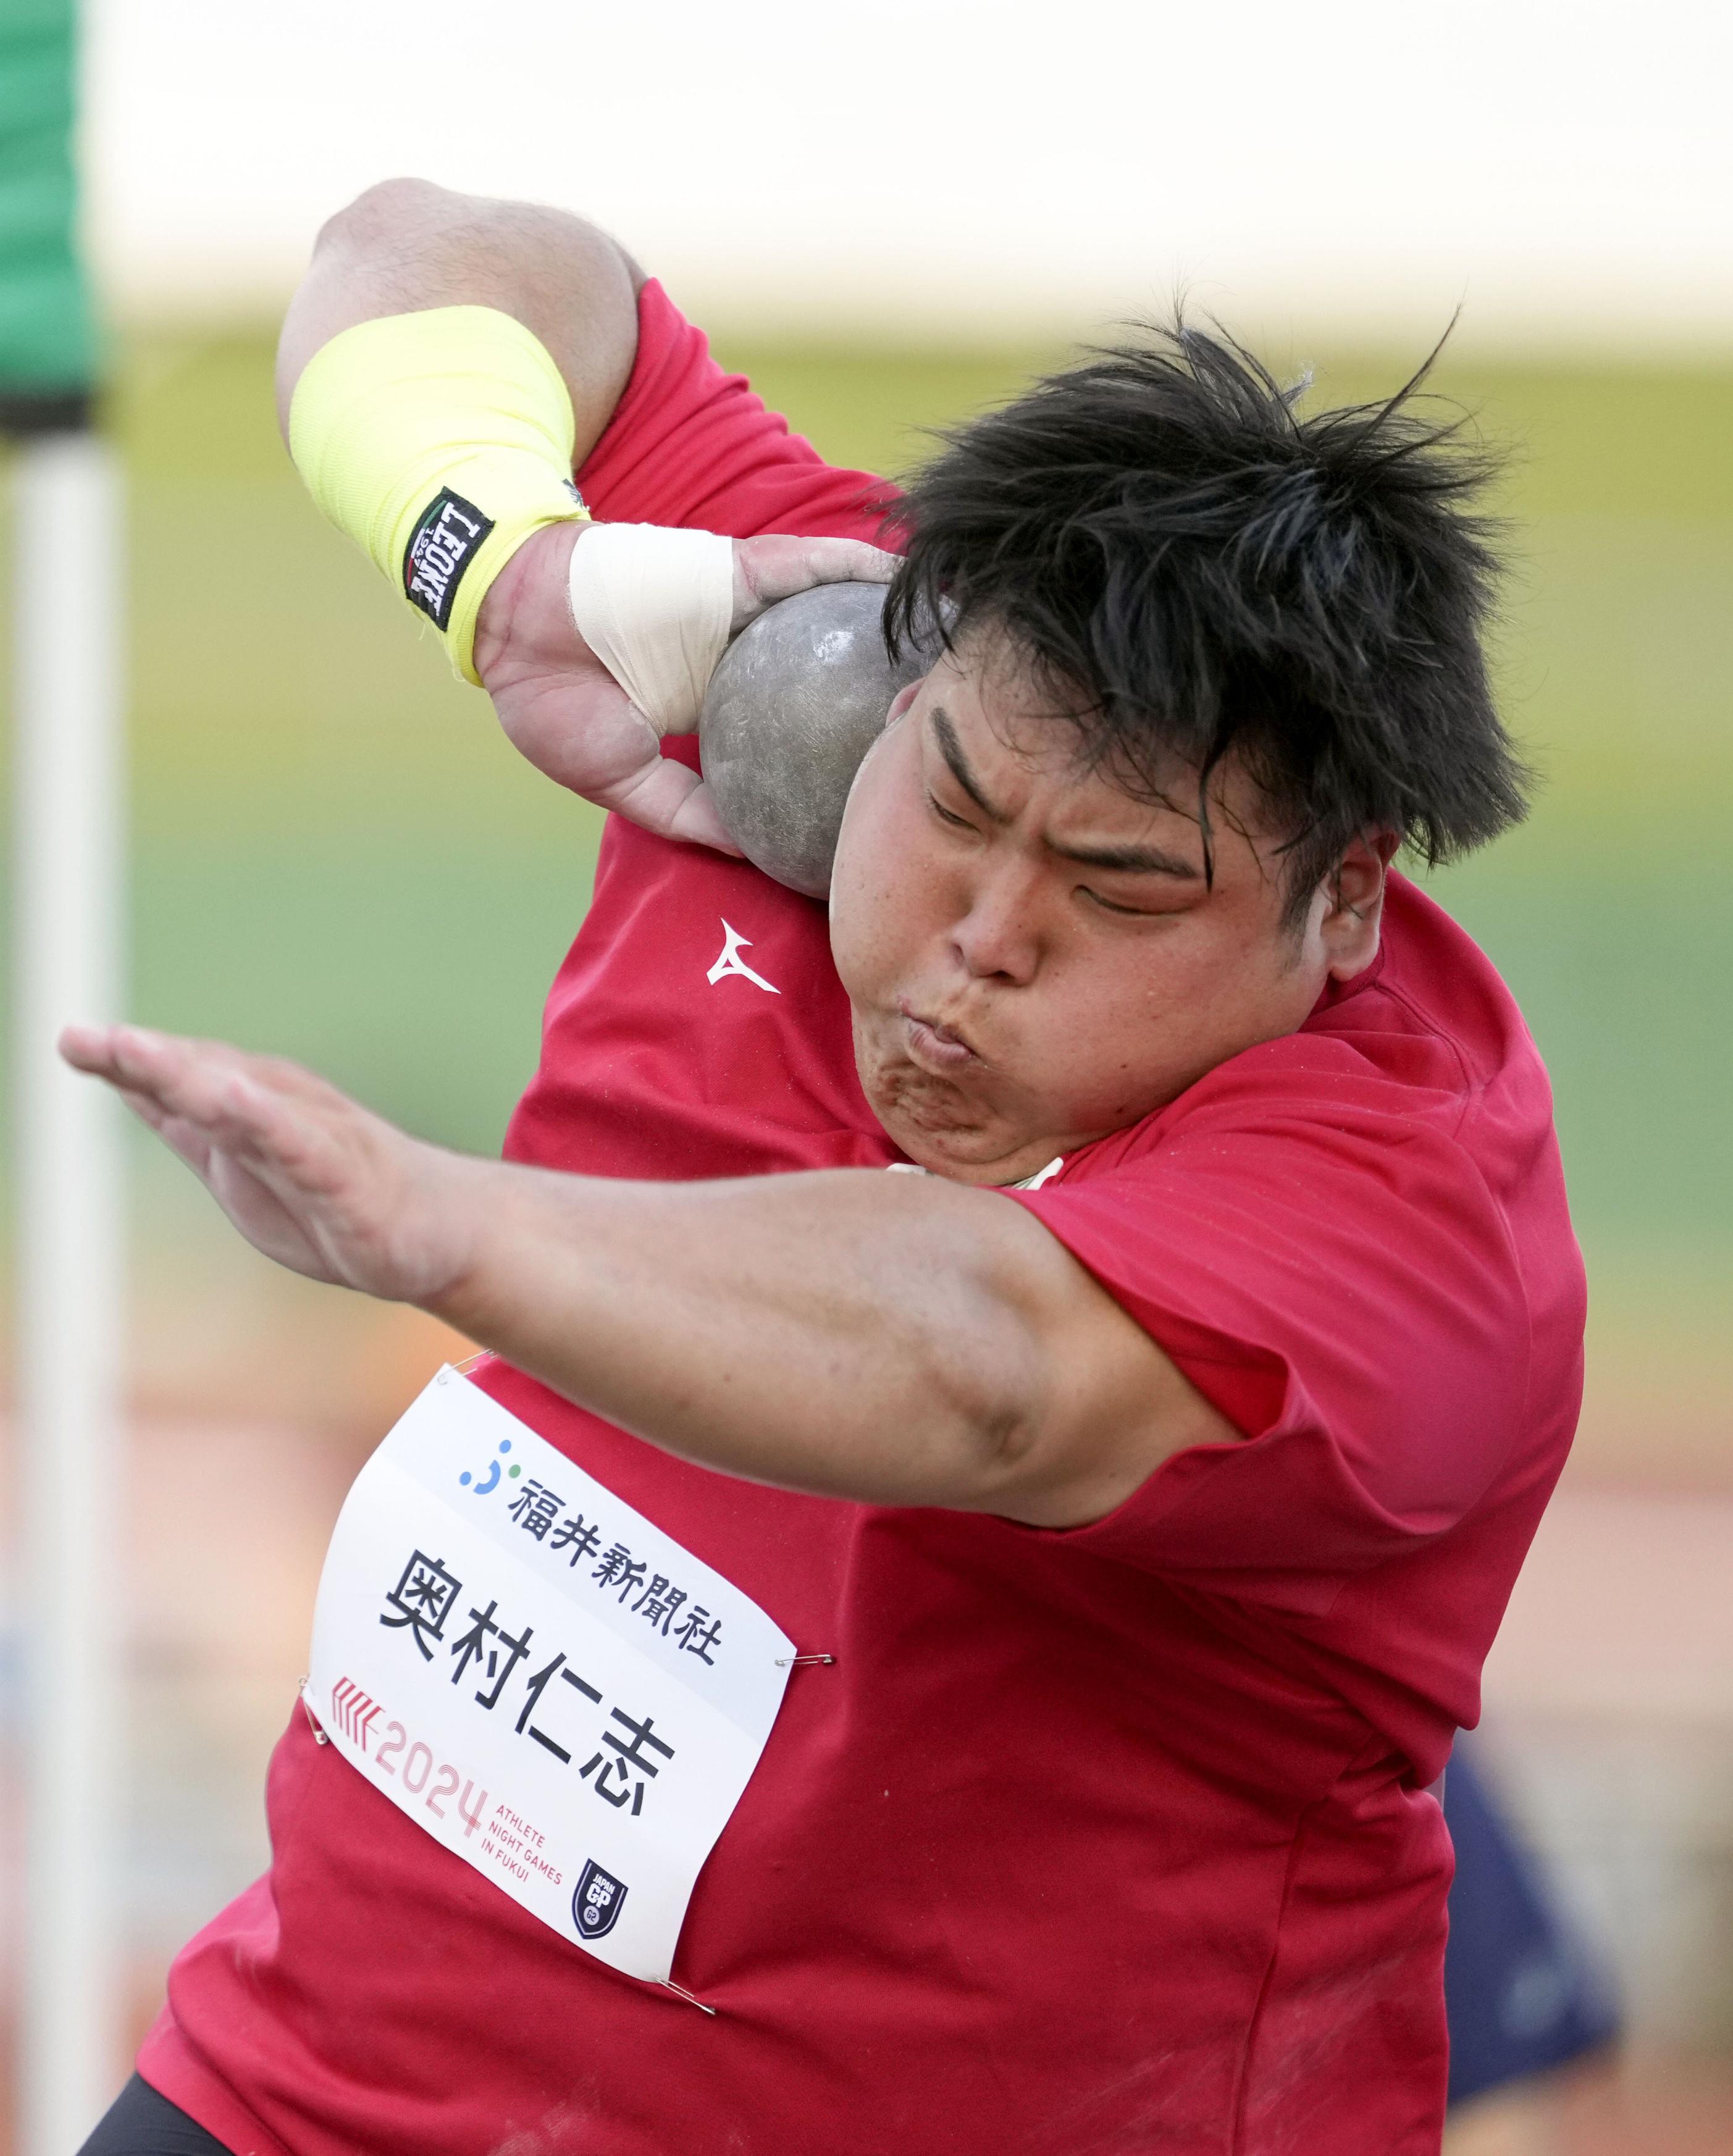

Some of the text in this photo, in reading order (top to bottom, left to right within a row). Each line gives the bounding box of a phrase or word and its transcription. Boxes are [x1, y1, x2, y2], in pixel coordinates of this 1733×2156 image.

[410, 501, 480, 616] LEONE
[413, 527, 435, 568] 1947
[508, 1479, 723, 1666] 福井新聞社
[380, 1549, 675, 1816] 奥村仁志
[375, 1721, 489, 1838] 2024
[496, 1805, 545, 1848] ATHLETE
[482, 1839, 529, 1882] IN FUKUI
[489, 1821, 563, 1885] NIGHT GAMES
[587, 1884, 611, 1908] GP
[593, 1874, 615, 1894] JAPAN
[587, 1910, 596, 1922] G2
